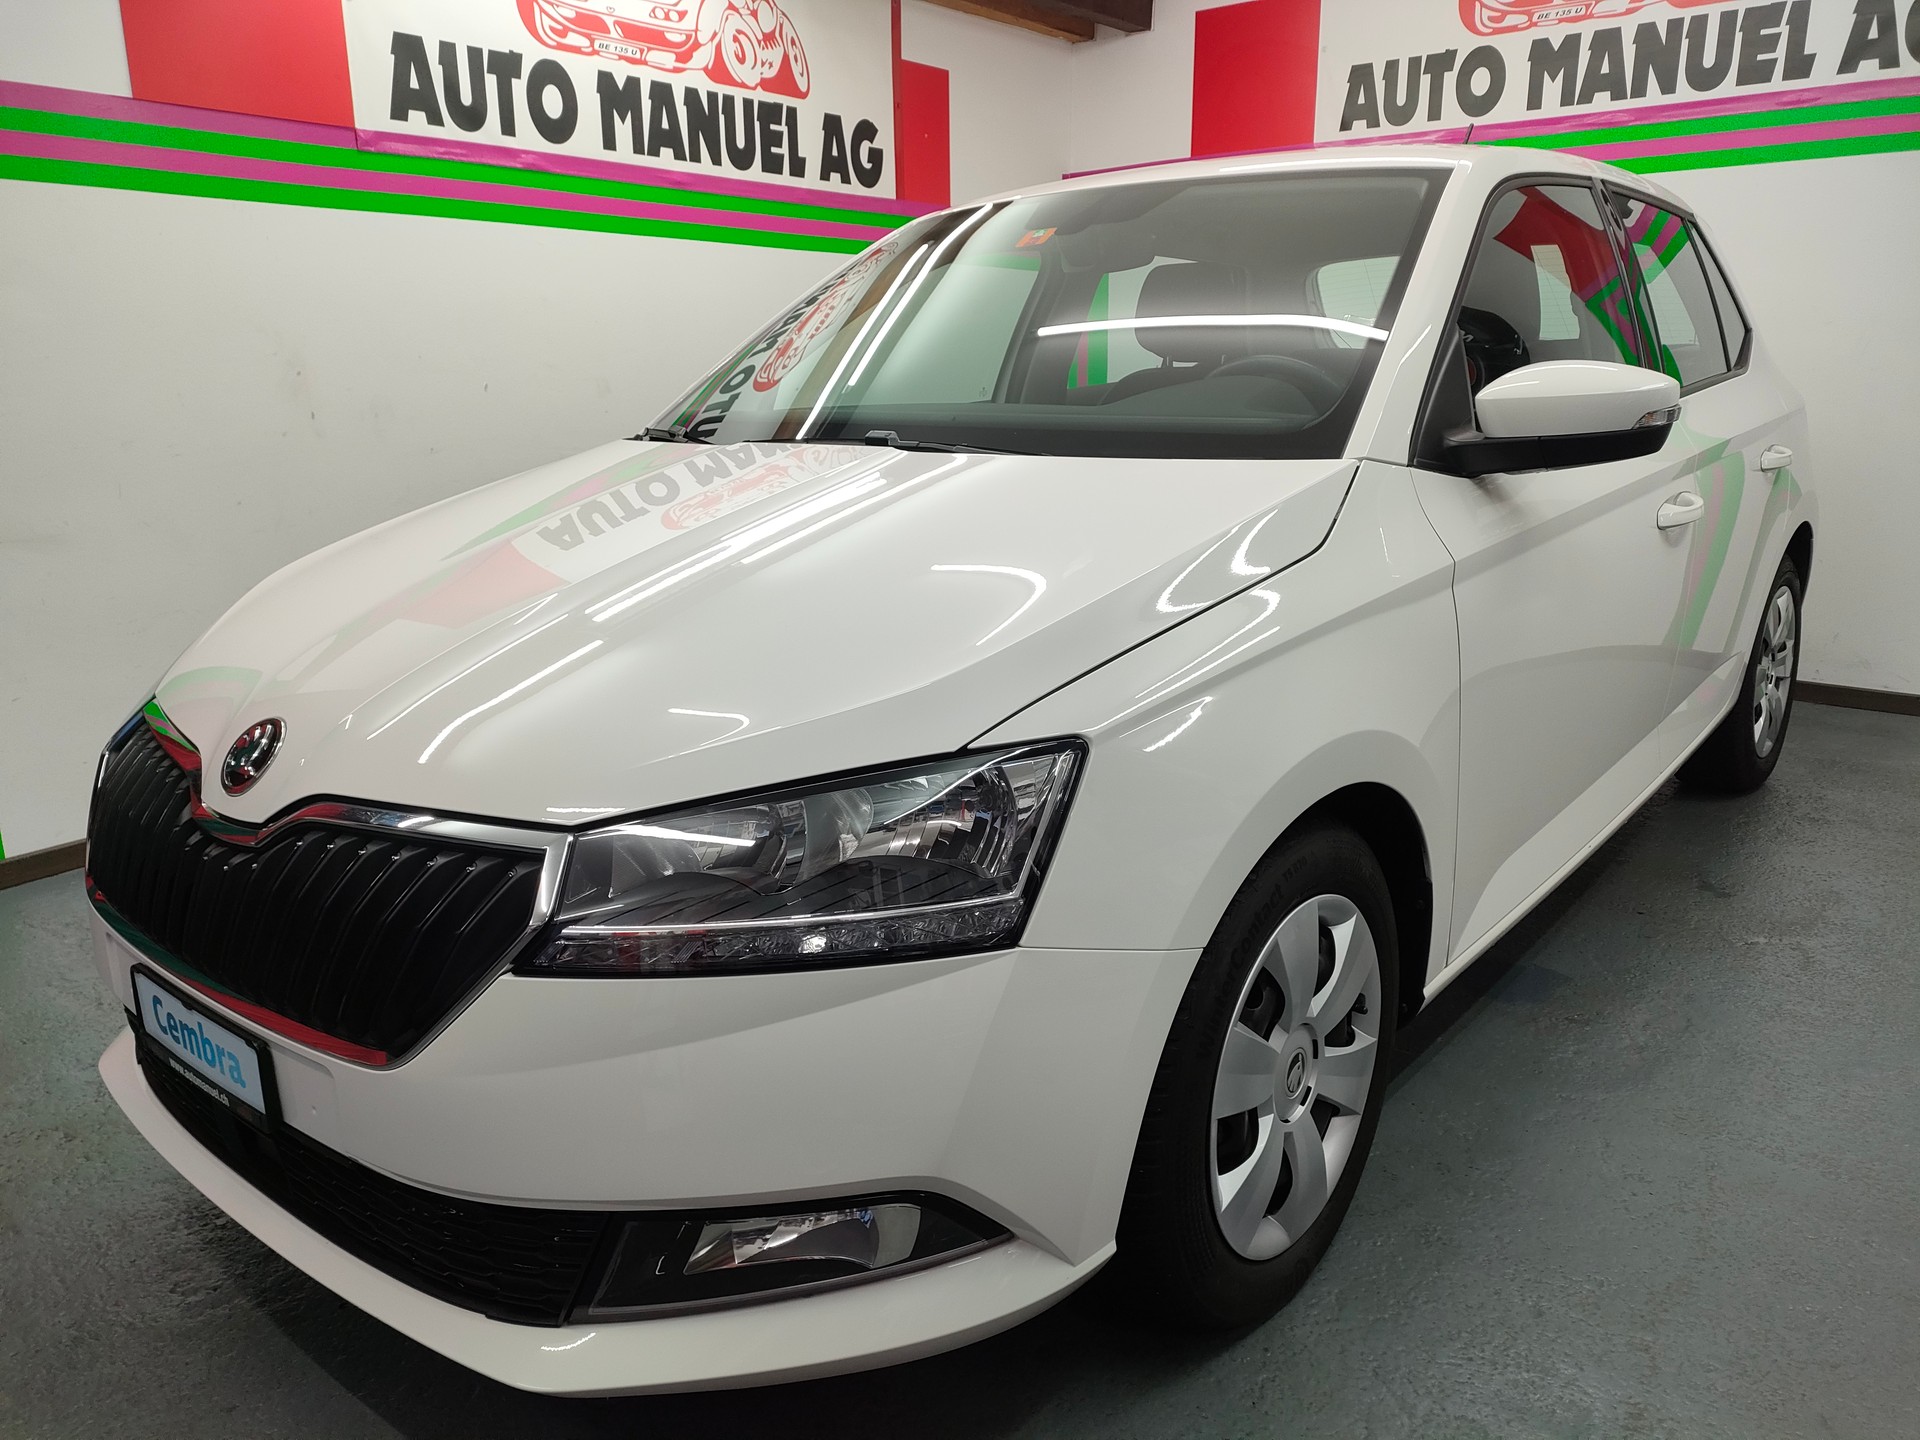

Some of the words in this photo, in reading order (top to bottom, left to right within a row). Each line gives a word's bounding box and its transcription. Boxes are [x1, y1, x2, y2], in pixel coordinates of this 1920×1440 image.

[598, 42, 609, 51] BE
[614, 45, 629, 54] 135
[1537, 12, 1551, 20] BE
[1555, 9, 1572, 17] 135
[389, 31, 579, 145] AUTO
[596, 69, 807, 179] MANUEL
[819, 114, 884, 189] AG
[1338, 45, 1507, 132] AUTO
[1526, 0, 1816, 111] MANUEL
[152, 994, 246, 1089] Cembra
